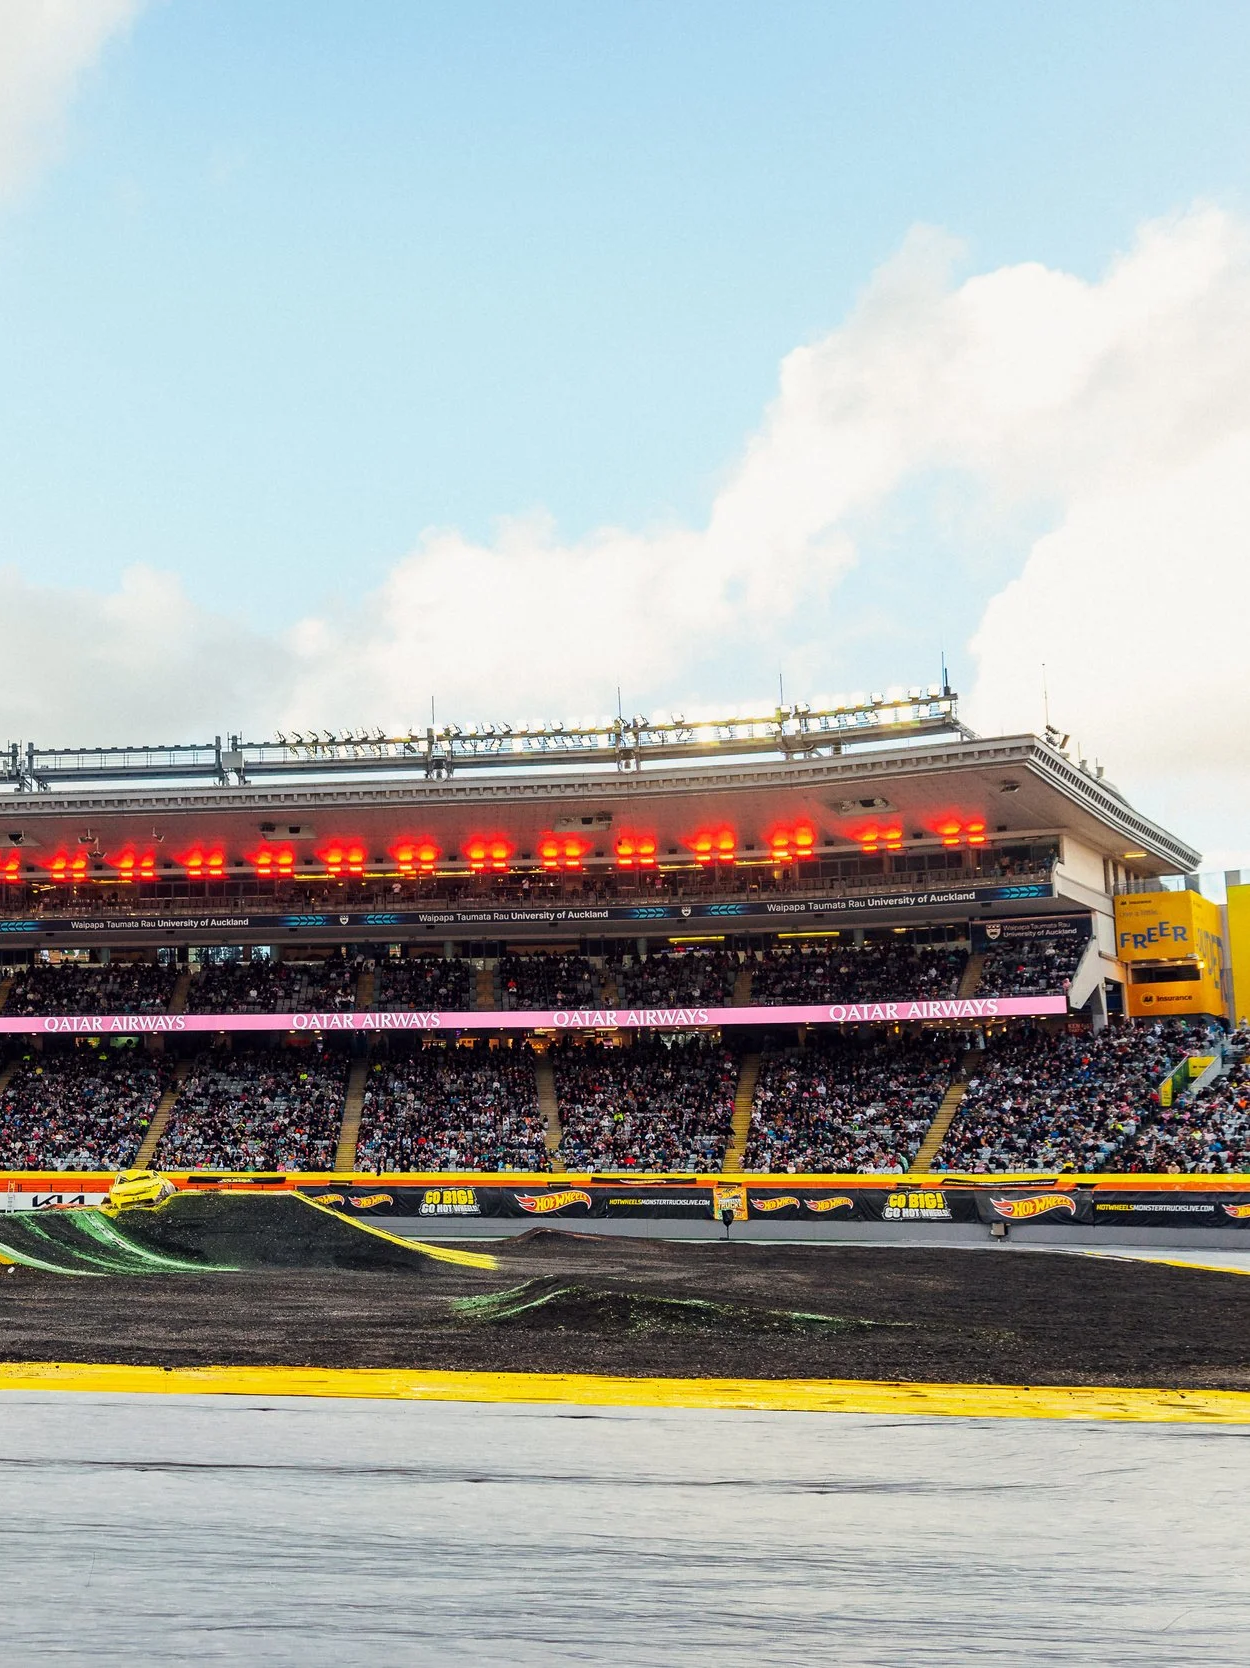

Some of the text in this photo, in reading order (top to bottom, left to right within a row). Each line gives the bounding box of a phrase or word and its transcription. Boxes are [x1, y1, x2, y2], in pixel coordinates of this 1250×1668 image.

[766, 891, 976, 913] Waipapa Taumata Rau University of Auckland
[71, 918, 249, 930] Waipapa Taumata Rau University of Auckland
[419, 910, 609, 923] Waipapa Taumata Rau University of Auckland
[1003, 930, 1036, 938] University
[1045, 928, 1077, 936] Auckland
[1119, 921, 1189, 949] FREER
[1156, 994, 1193, 1002] Insurance
[553, 1008, 709, 1028] QATAR AIRWAYS
[829, 999, 999, 1022] QATAR AIRWAYS
[44, 1015, 185, 1033] QATAR AIRWAYS
[292, 1012, 441, 1030] QATAR AIRWAYS
[32, 1194, 85, 1207] KIA
[424, 1190, 474, 1205] GO BIG!
[535, 1196, 555, 1212] HOT
[888, 1192, 944, 1209] GO BIG!
[420, 1204, 436, 1214] GO
[436, 1204, 453, 1213] HOT
[884, 1207, 901, 1218] GO
[902, 1208, 920, 1218] HOT
[1012, 1202, 1036, 1217] HOT
[1096, 1204, 1215, 1212] HOTWHEELSMONSTERTRUCKSLIVE.COM
